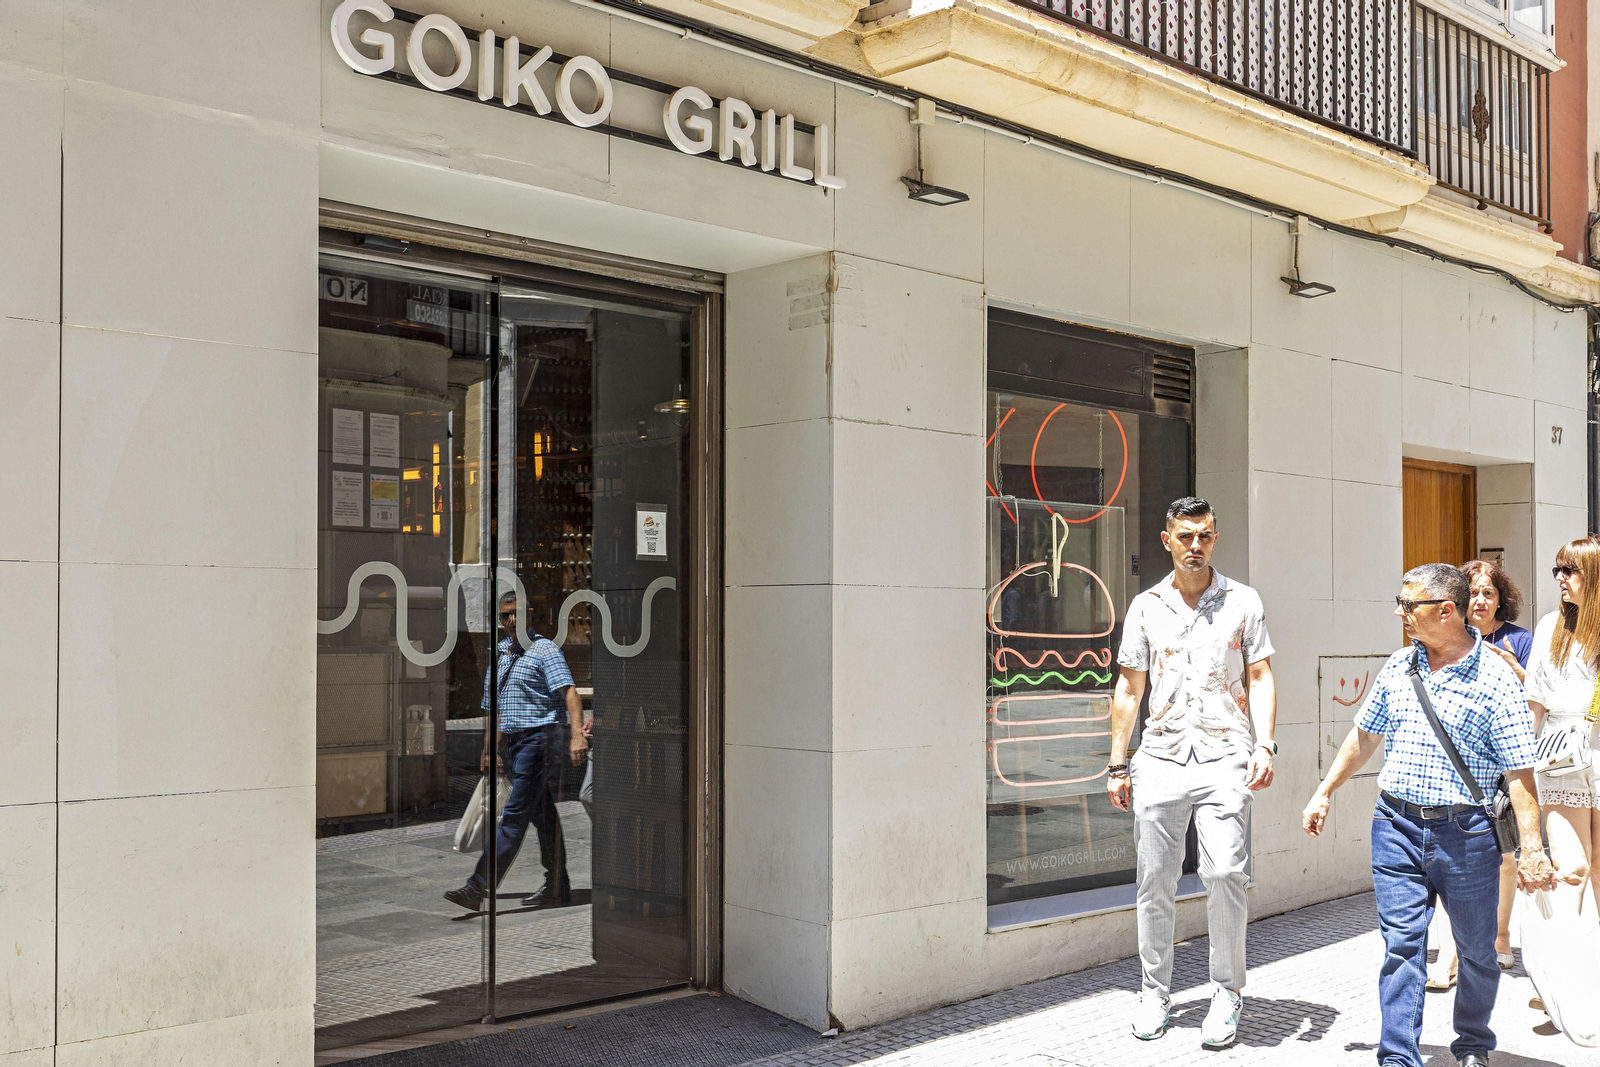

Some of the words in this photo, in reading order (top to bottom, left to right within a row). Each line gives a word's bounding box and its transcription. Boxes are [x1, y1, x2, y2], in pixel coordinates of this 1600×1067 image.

[330, 0, 614, 127] GOIKO
[663, 86, 847, 189] GRILL
[1551, 426, 1563, 445] 37
[1006, 847, 1127, 873] WWW.GOIKOGRILL.COM
